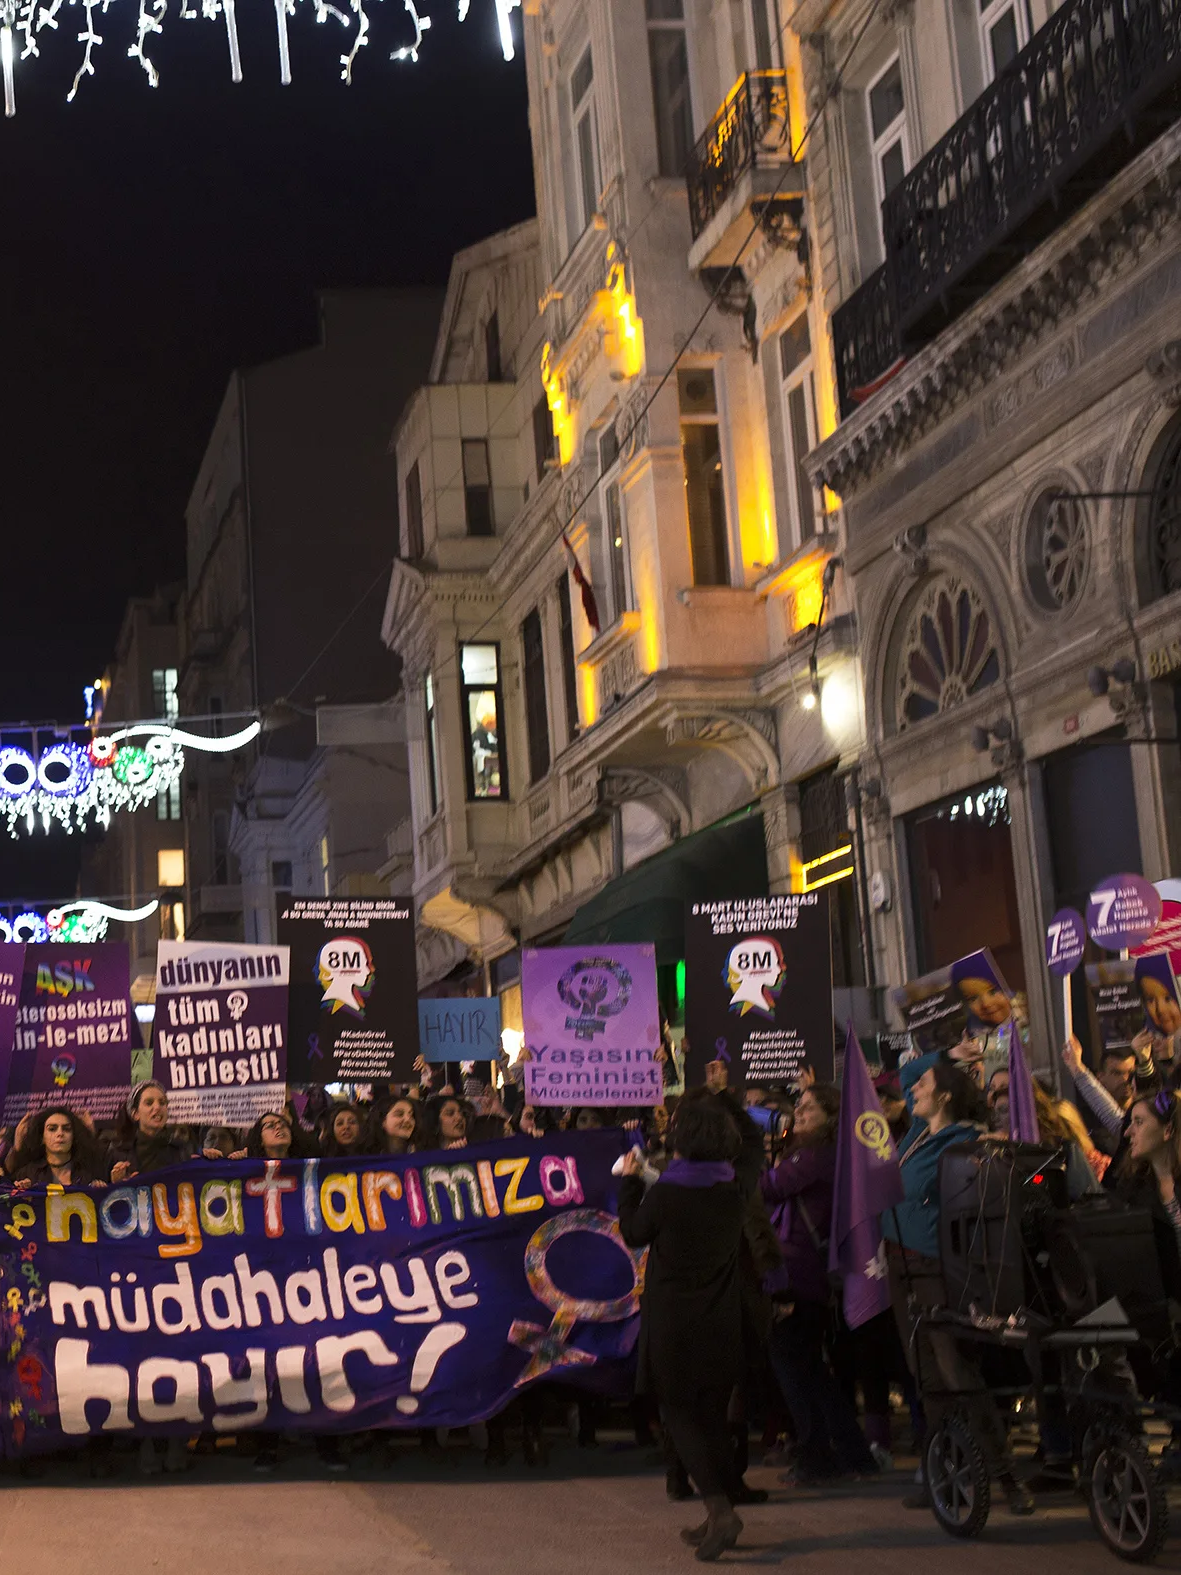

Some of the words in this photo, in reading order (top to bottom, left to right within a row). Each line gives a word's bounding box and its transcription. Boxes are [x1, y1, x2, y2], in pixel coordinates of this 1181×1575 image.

[692, 903, 699, 915] 8
[701, 901, 732, 915] MART
[734, 893, 818, 912] ULUSLARARASI
[711, 911, 745, 924] KADIN
[1090, 888, 1117, 928] 7
[713, 923, 734, 935] SES
[736, 918, 798, 933] VERİYORUZ
[1048, 921, 1061, 958] 7
[159, 953, 282, 988] dünyanın
[327, 951, 361, 968] 8M
[737, 950, 772, 970] 8M
[35, 959, 95, 998] AŞK
[15, 998, 128, 1026] teroseksizm
[167, 999, 220, 1027] tüm
[12, 1017, 129, 1052] in-le-mez!
[158, 1024, 284, 1059] kadınları
[530, 1044, 654, 1068] Yaşasın
[169, 1051, 280, 1090] birleşti!
[531, 1066, 659, 1085] Feminist
[530, 1087, 660, 1100] Mücadelemiz!
[49, 1246, 479, 1334] müdahaleye
[53, 1321, 468, 1436] hayır!
